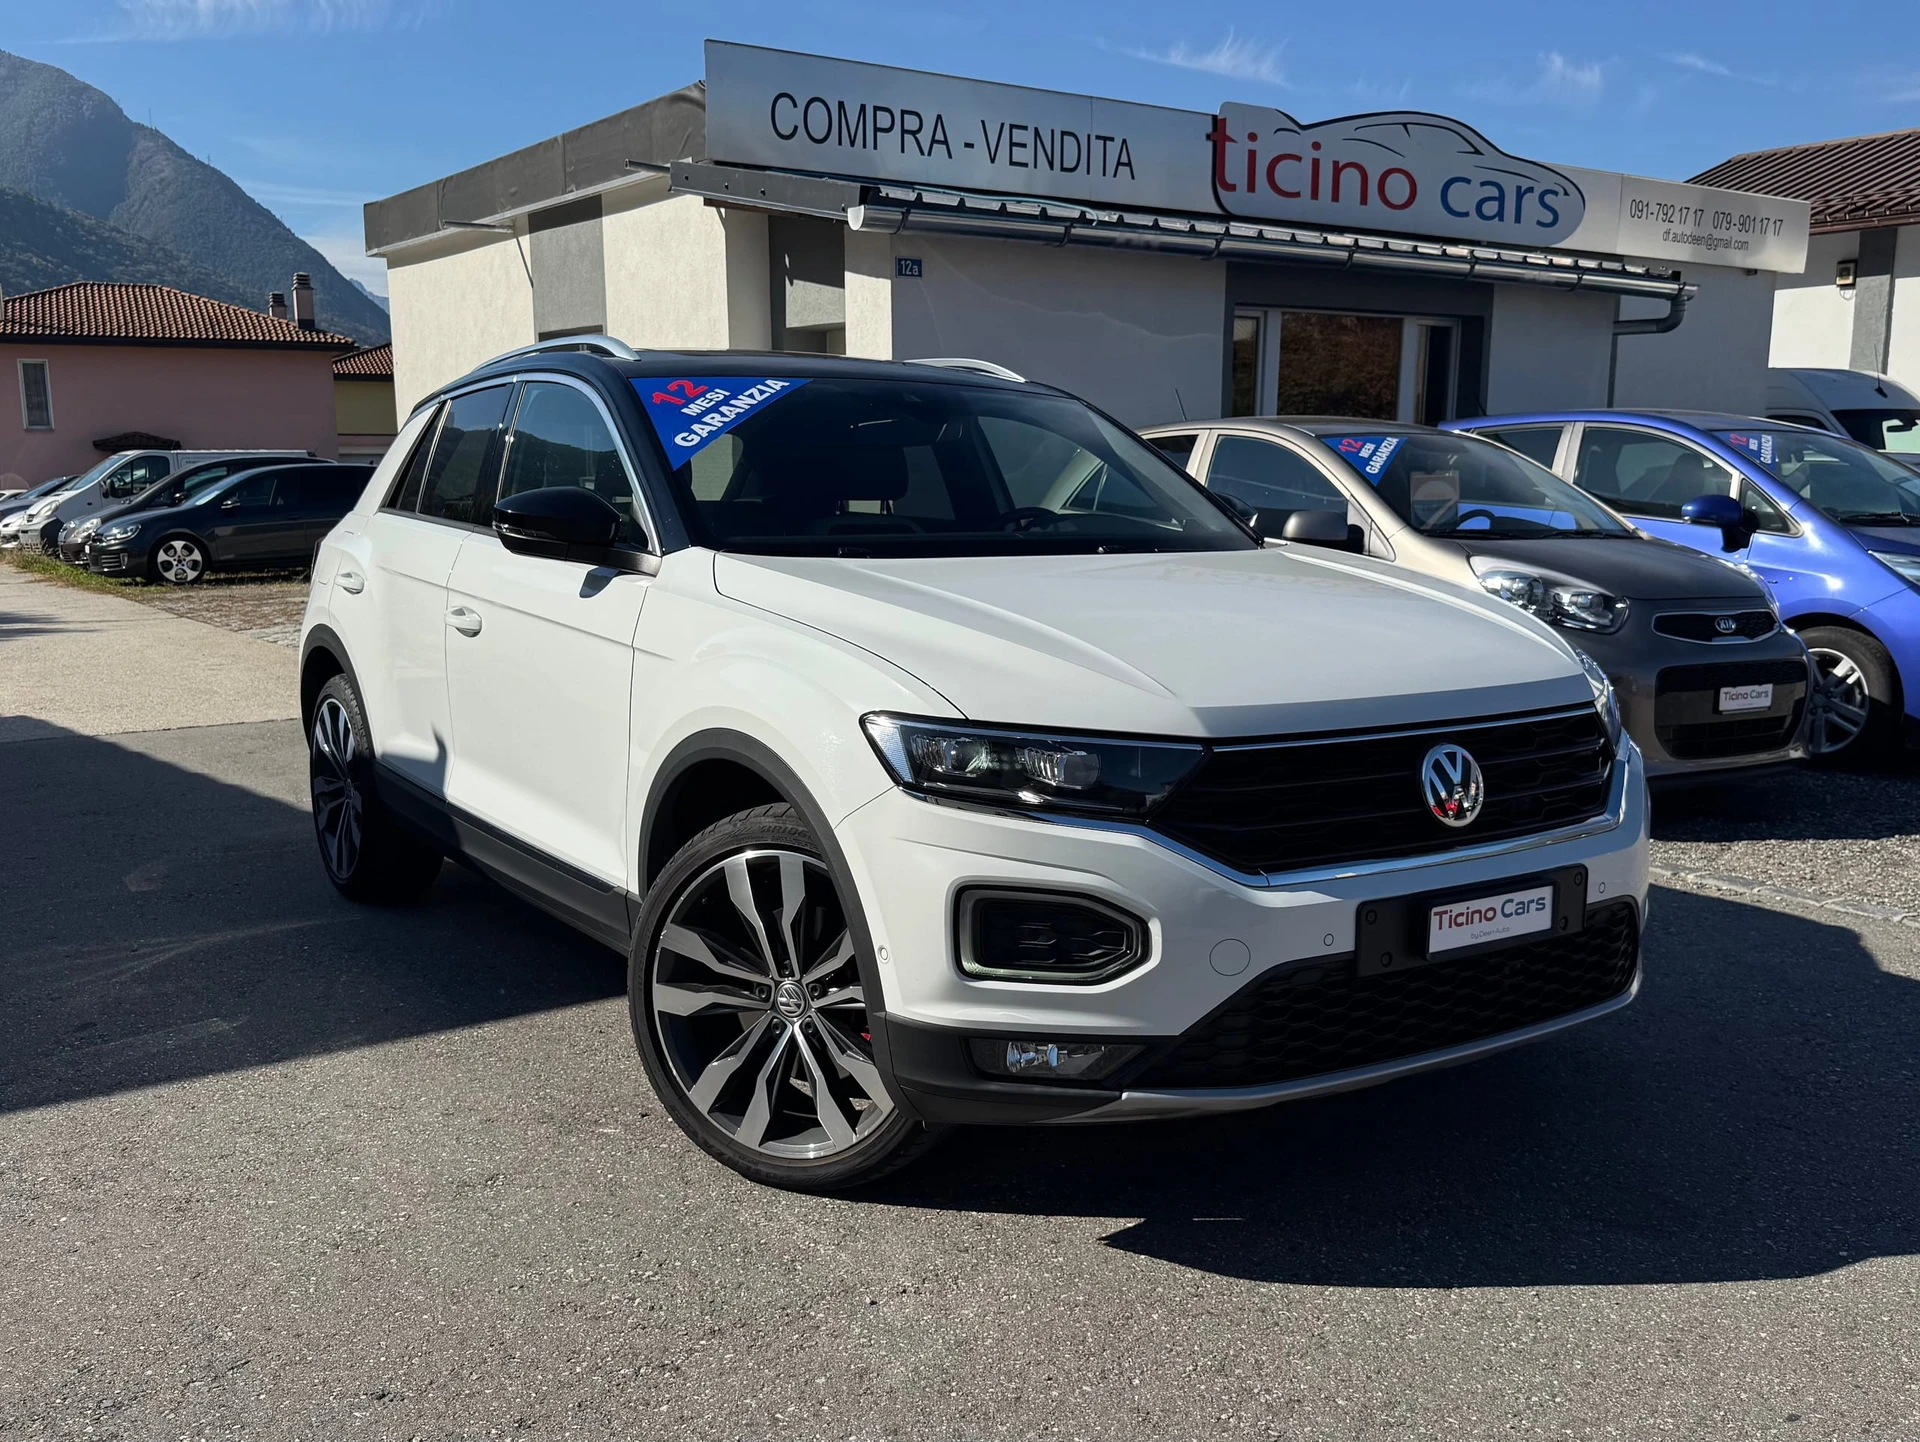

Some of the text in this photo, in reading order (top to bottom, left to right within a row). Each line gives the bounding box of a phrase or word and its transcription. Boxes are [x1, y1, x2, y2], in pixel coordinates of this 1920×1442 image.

[770, 92, 953, 160] COMPRA
[980, 119, 1135, 181] VENDITA
[1208, 117, 1560, 229] ticino cars
[1678, 205, 1690, 226] 17
[1692, 207, 1705, 228] 17
[1758, 216, 1771, 236] 17
[1772, 218, 1784, 237] 17
[1662, 228, 1749, 252] df.autodeen@gmail.com
[900, 260, 919, 276] 12a
[652, 379, 709, 406] 12
[680, 388, 732, 417] MESI
[674, 379, 791, 447] GARANZIA
[1338, 438, 1363, 453] 12
[1365, 436, 1400, 474] GARANZIA
[1723, 689, 1769, 702] Ticino Cars
[1433, 896, 1546, 930] Ticino Cars
